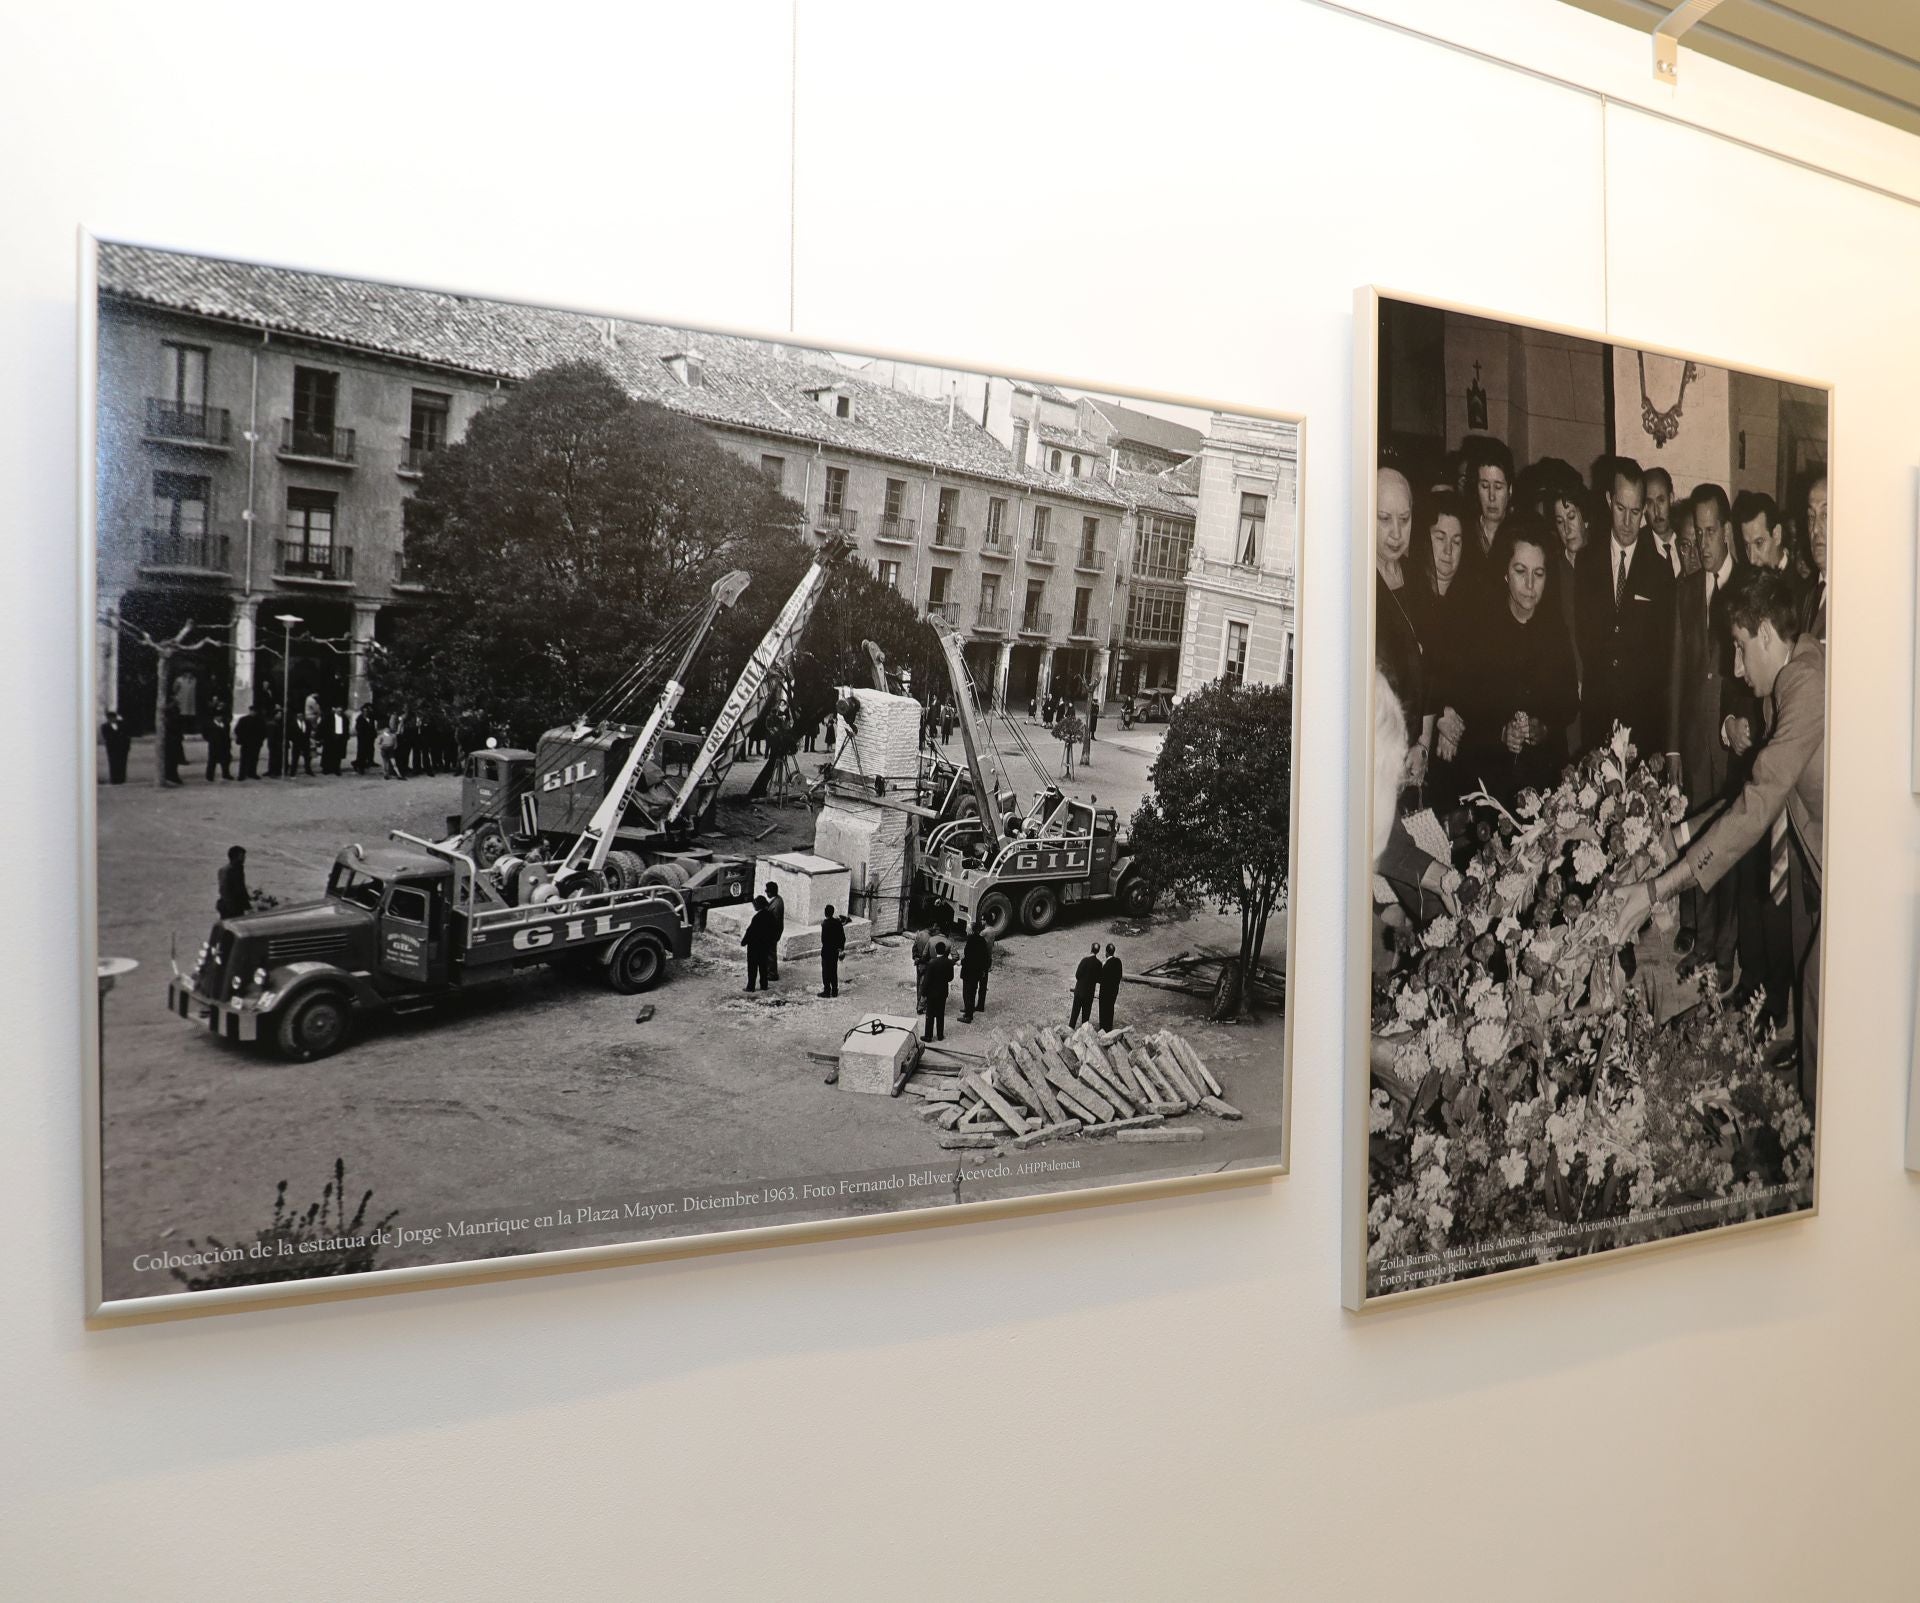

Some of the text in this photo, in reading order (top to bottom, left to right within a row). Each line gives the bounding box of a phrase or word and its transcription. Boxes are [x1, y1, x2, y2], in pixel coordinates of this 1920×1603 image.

[706, 699, 741, 754] GRUAS
[543, 761, 597, 791] GIL
[1016, 852, 1085, 869] GIL
[513, 915, 631, 950] GIL
[132, 1158, 1081, 1272] Colocación de la estatua de Jorge Manrique en la Plaza Mayor. Diciembre 1963. Foto Fernando Bellver Acevedo. AHPPalencia
[1380, 1256, 1404, 1271] Zoila
[1442, 1244, 1466, 1259] viuda
[1468, 1246, 1474, 1257] y
[1476, 1241, 1494, 1253] Luis
[1496, 1236, 1527, 1249] Alonso,
[1567, 1224, 1577, 1235] de
[1579, 1219, 1611, 1233] Victorio
[1380, 1274, 1401, 1287] Foto
[1403, 1264, 1446, 1282] Fernando
[1448, 1259, 1478, 1273] Bellver
